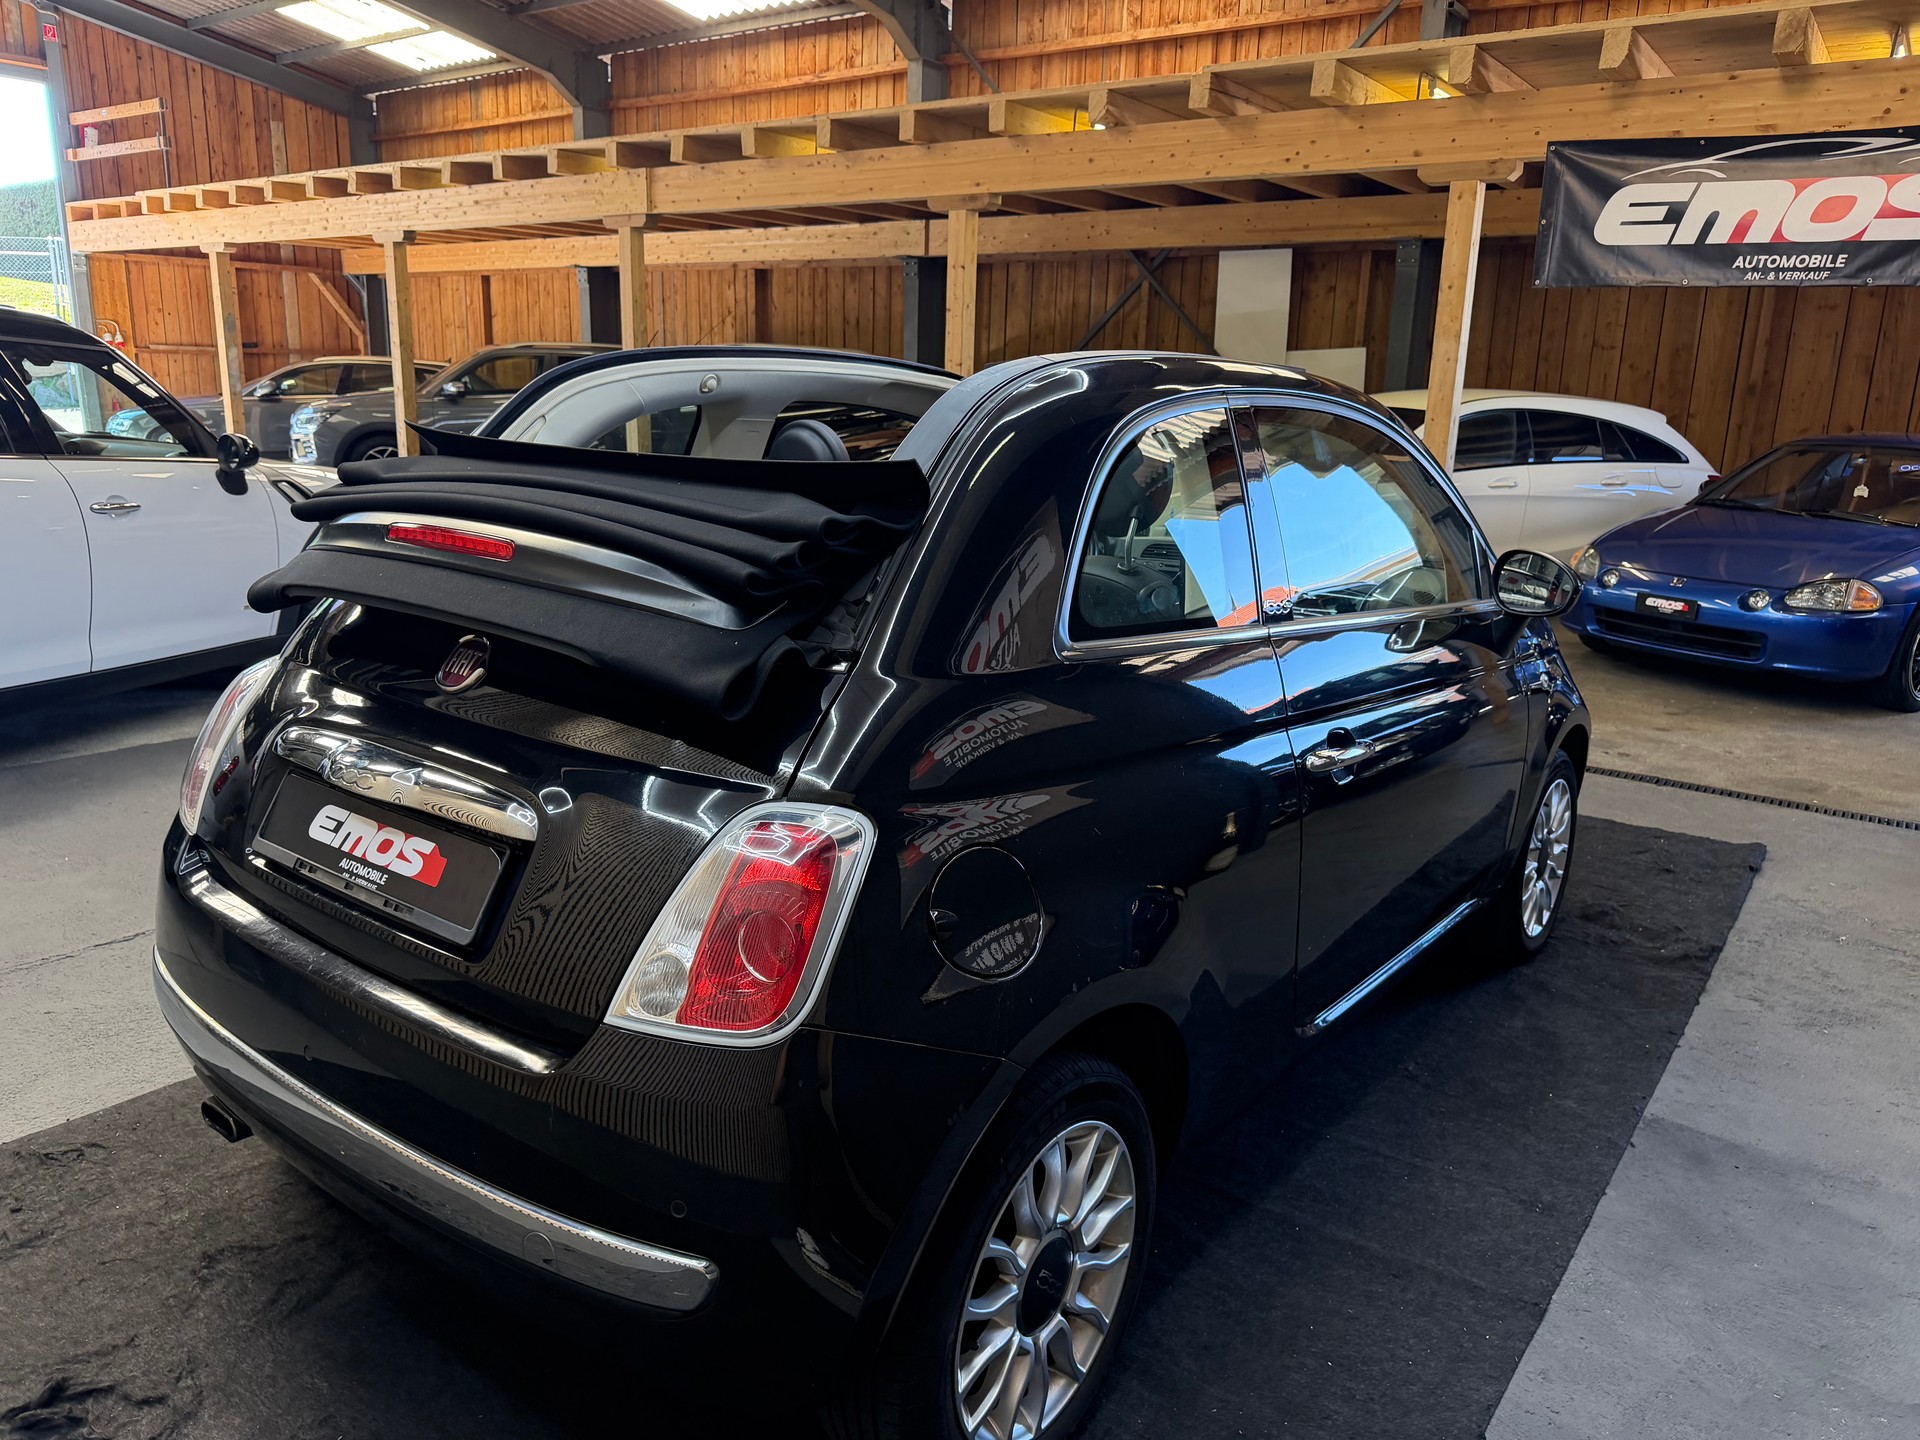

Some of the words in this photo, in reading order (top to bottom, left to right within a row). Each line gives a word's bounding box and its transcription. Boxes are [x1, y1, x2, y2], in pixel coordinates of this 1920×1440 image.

[1732, 254, 1849, 269] AUTOMOBILE
[1744, 271, 1765, 281] AN-
[1767, 271, 1776, 281] &
[1779, 271, 1831, 281] VERKAUF
[1645, 596, 1686, 611] EMOS
[445, 648, 483, 676] FIAT
[308, 804, 437, 877] EMOS
[338, 857, 389, 885] AUTOMOBILE
